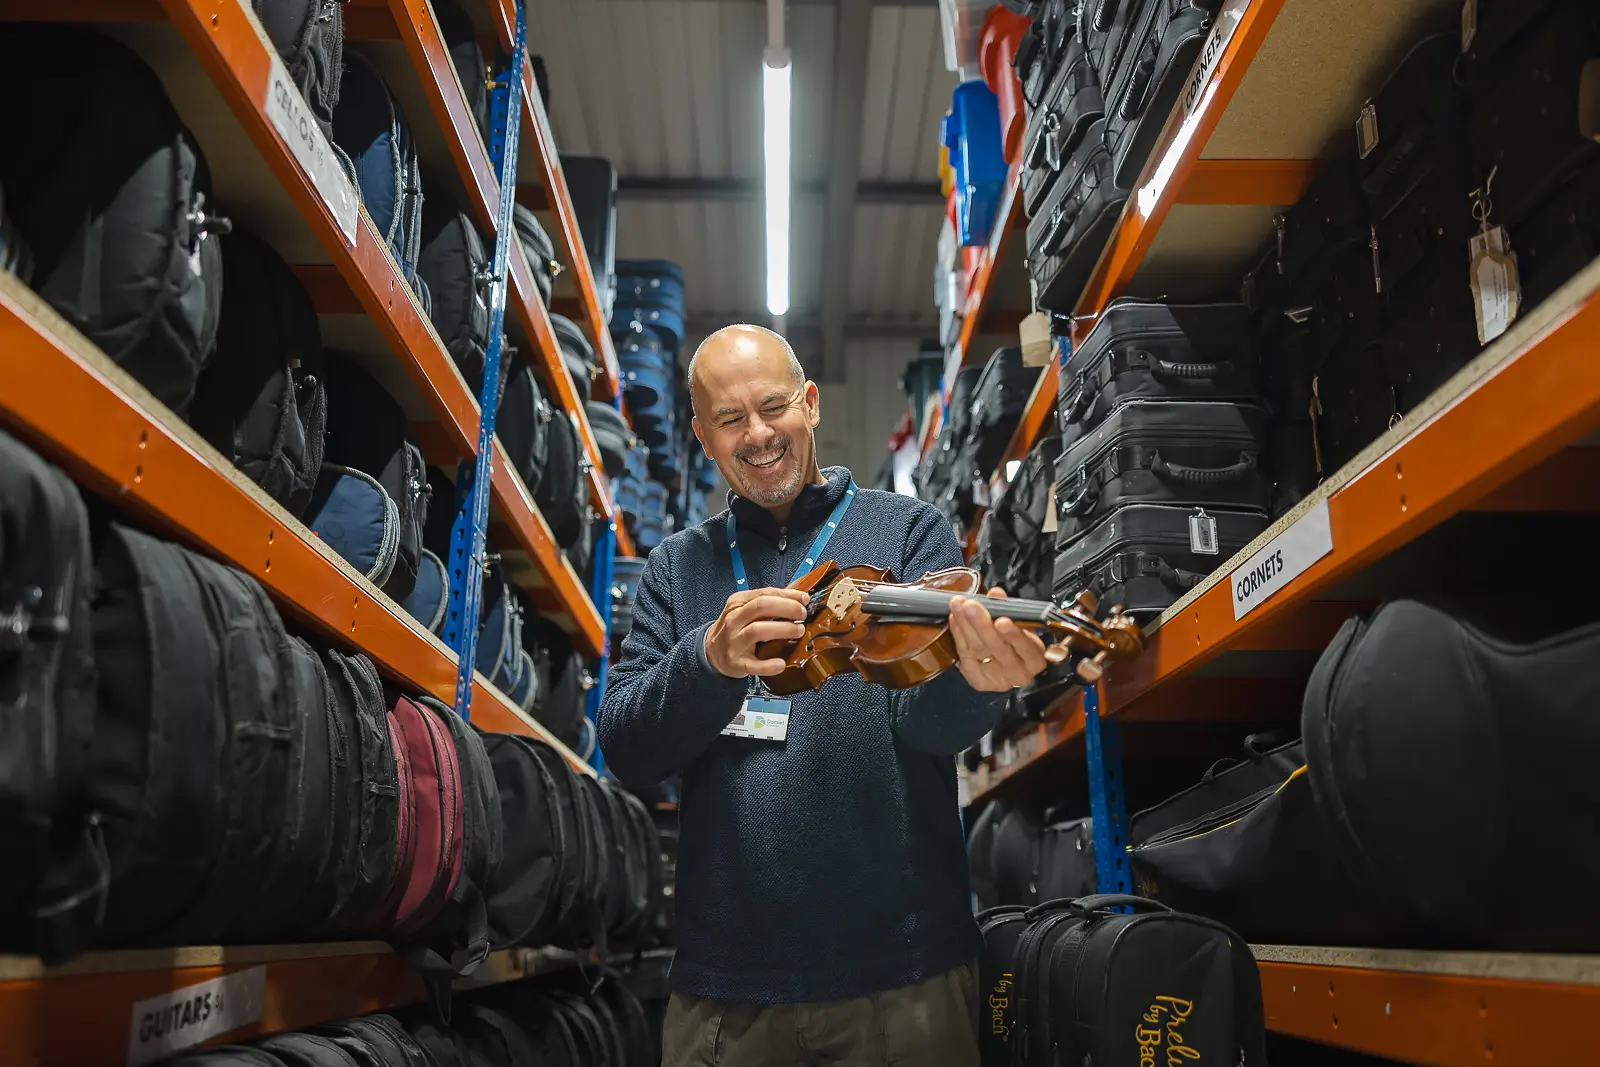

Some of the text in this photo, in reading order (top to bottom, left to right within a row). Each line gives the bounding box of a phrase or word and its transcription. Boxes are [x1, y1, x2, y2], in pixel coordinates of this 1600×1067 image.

[1185, 28, 1222, 110] CORNETS
[1236, 549, 1284, 602] CORNETS
[139, 992, 212, 1043] GUITARS
[989, 994, 1009, 1035] Bach
[1143, 1004, 1168, 1023] by
